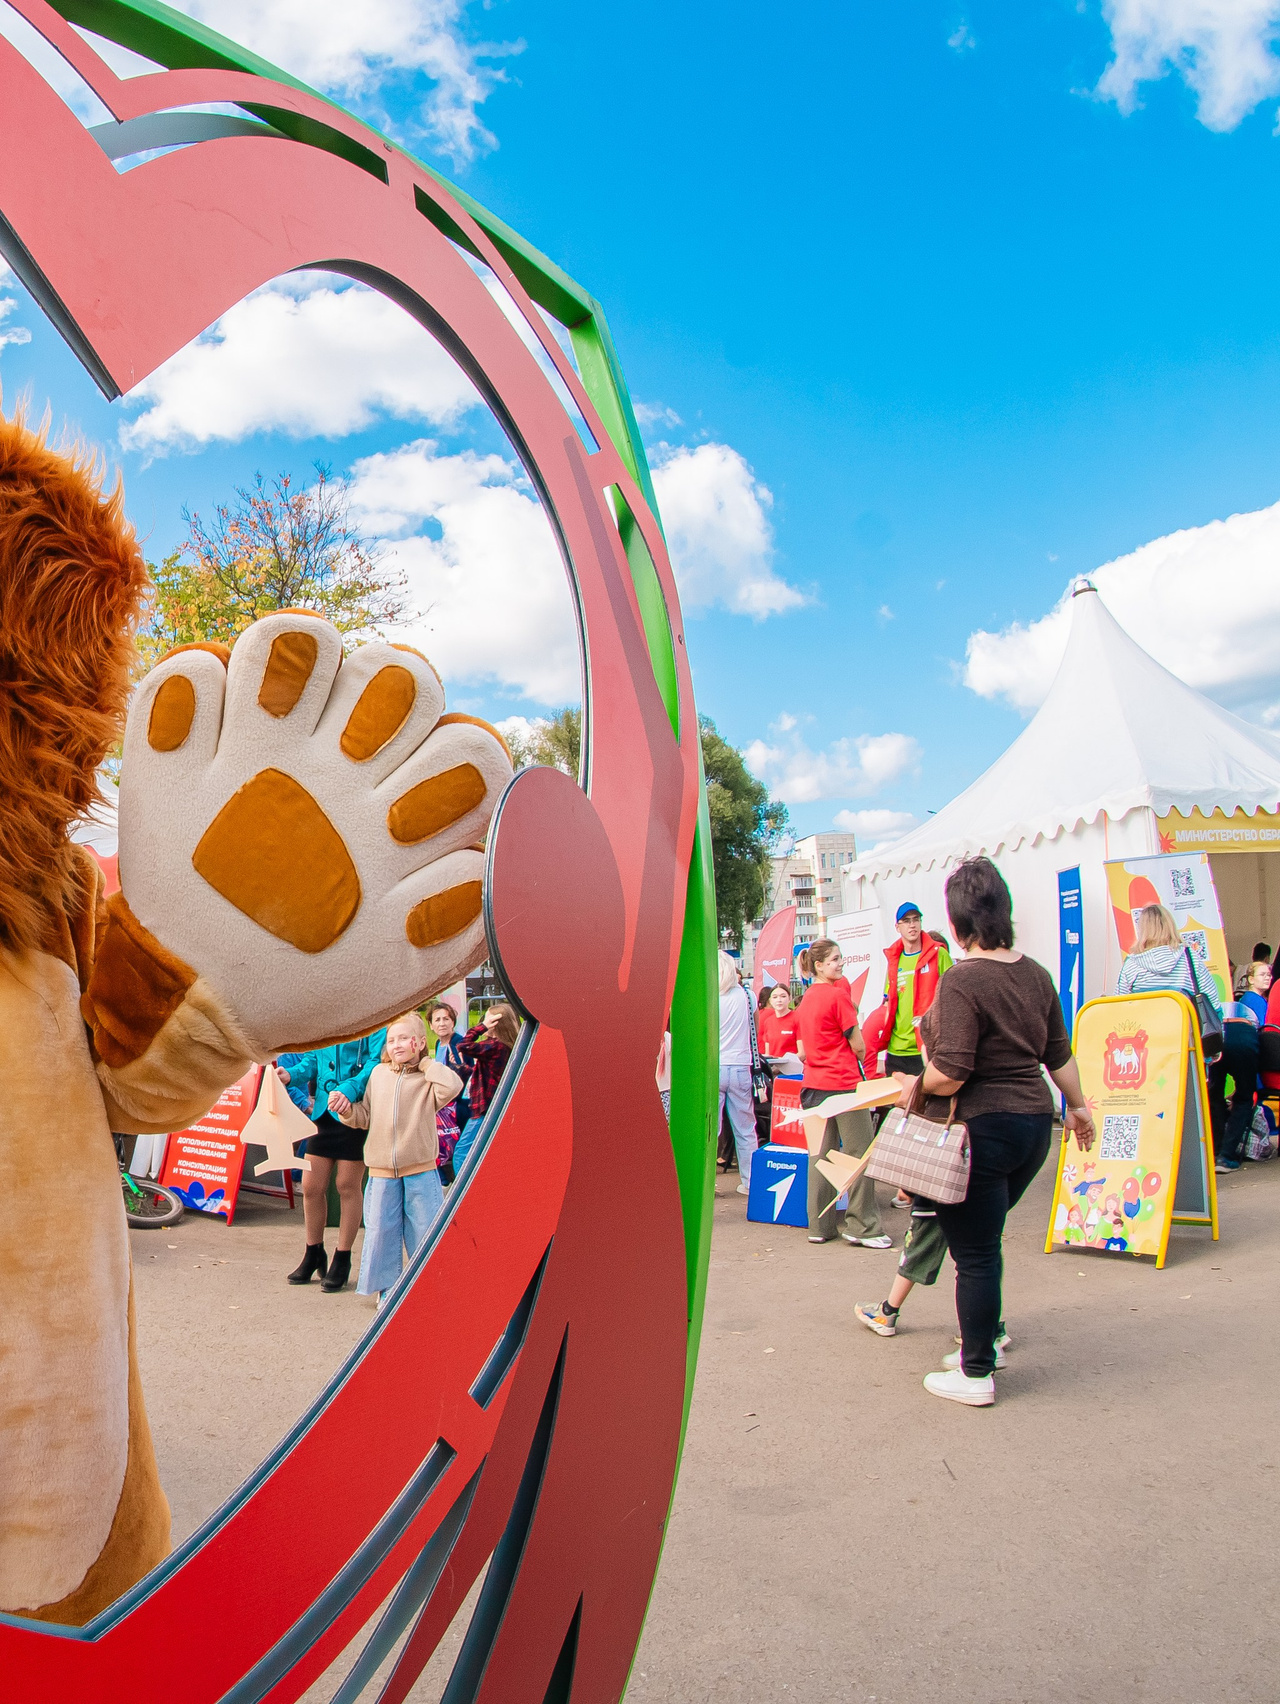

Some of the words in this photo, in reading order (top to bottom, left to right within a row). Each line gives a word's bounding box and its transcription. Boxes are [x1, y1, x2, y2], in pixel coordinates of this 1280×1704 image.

[1175, 829, 1257, 842] МИНИСТЕРСТВО
[843, 953, 871, 966] ервые
[204, 1112, 230, 1121] АНСИИ
[177, 1137, 236, 1152] ДОПОЛНИТЕЛЬНОЕ
[182, 1146, 228, 1160] ОБРАЗОВАНИЕ
[177, 1159, 227, 1174] КОНСУЛЬТАЦИИ
[766, 1160, 798, 1171] Первые
[179, 1168, 228, 1183] ТЕСТИРОВАНИЕ
